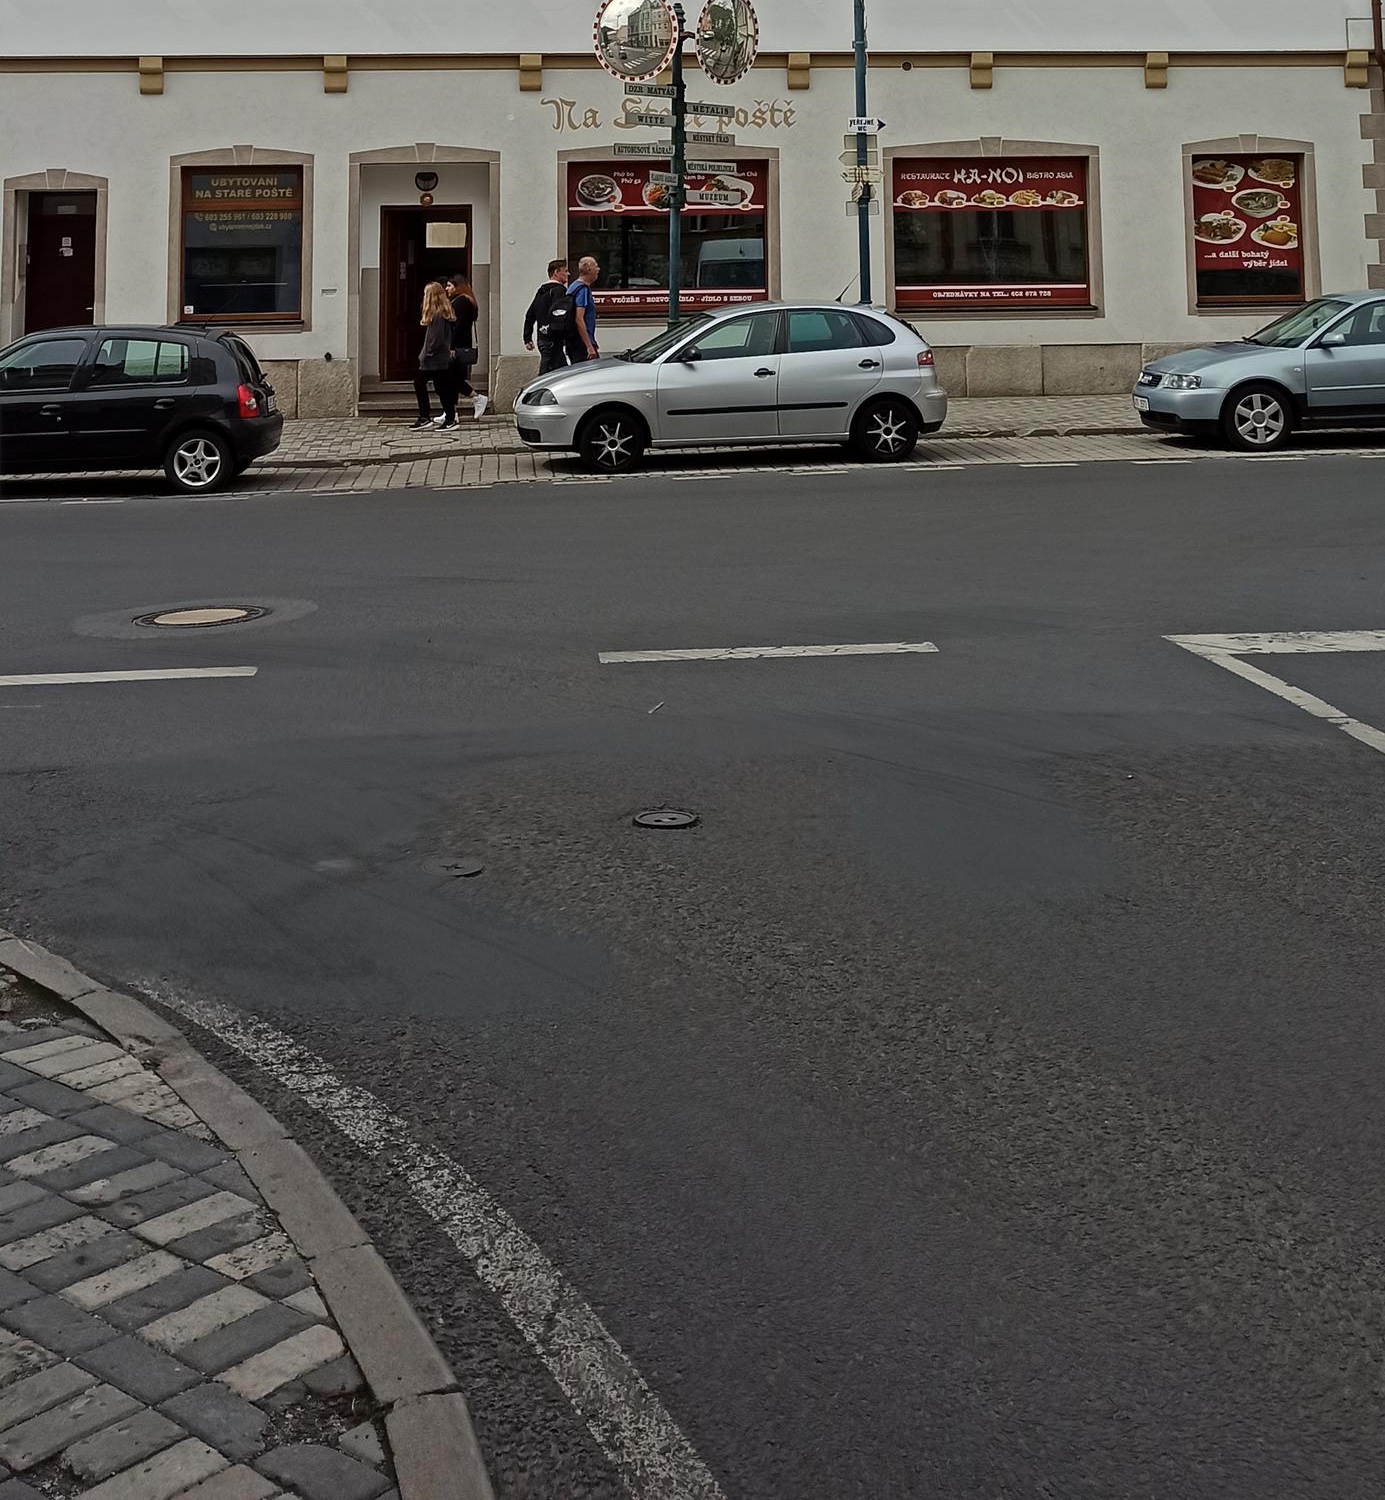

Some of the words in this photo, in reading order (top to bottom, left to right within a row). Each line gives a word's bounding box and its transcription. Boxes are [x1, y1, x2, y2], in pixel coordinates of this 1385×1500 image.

[693, 105, 729, 115] METALIS
[541, 97, 601, 134] Na
[637, 115, 665, 124] WITTE
[900, 172, 951, 180] RESTAURACE
[953, 167, 1023, 185] HA-NOI
[1026, 171, 1054, 179] BISTRO
[1056, 171, 1074, 179] ASIA
[195, 190, 211, 198] NA
[215, 188, 252, 198] STARÉ
[699, 193, 729, 201] MUZEUM
[1219, 250, 1239, 258] další
[1241, 250, 1269, 259] bohatý
[1242, 260, 1268, 269] výběr
[1269, 259, 1289, 268] jídel
[932, 290, 978, 298] OBJEDNÁVKY
